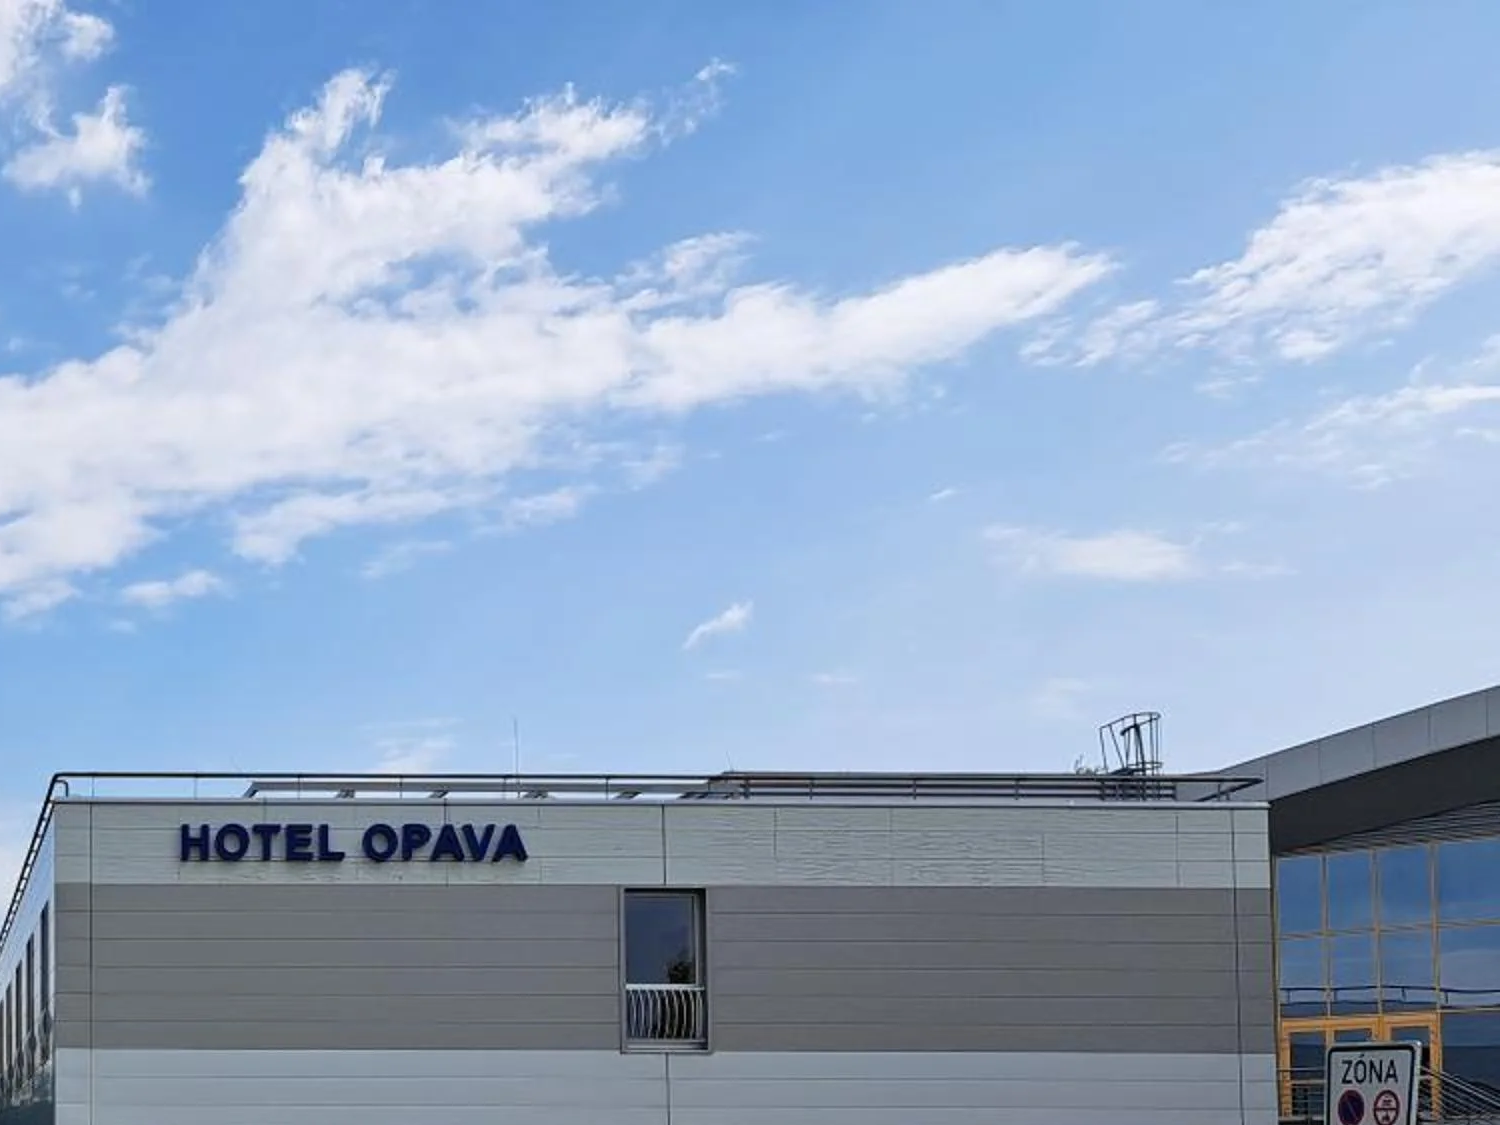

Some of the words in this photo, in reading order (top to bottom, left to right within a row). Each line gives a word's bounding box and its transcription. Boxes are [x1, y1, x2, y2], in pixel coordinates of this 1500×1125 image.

[180, 823, 345, 862] HOTEL
[362, 823, 528, 862] OPAVA
[1341, 1054, 1398, 1084] ZÓNA
